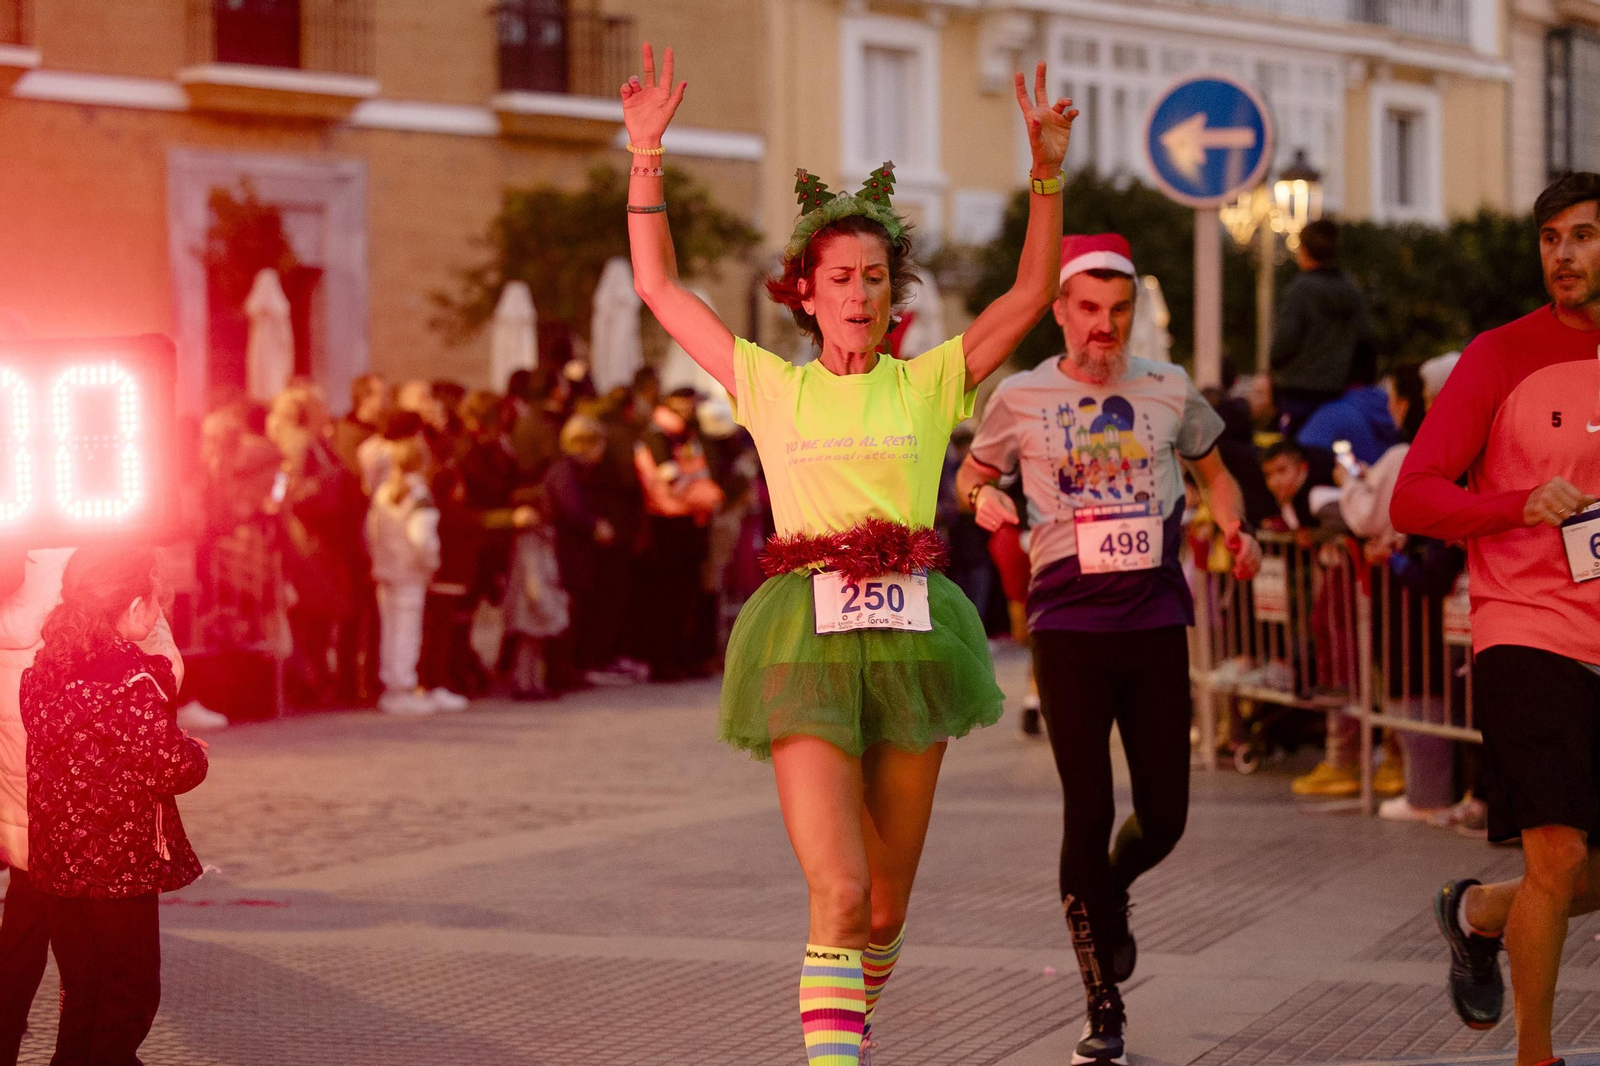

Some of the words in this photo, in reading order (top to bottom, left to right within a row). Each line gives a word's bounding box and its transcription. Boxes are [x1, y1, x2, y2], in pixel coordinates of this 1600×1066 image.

[1551, 411, 1562, 428] 5
[785, 441, 798, 454] YO
[801, 439, 820, 450] ME
[822, 437, 854, 449] UNO
[859, 435, 877, 447] AL
[1100, 530, 1150, 557] 498
[840, 582, 905, 614] 250
